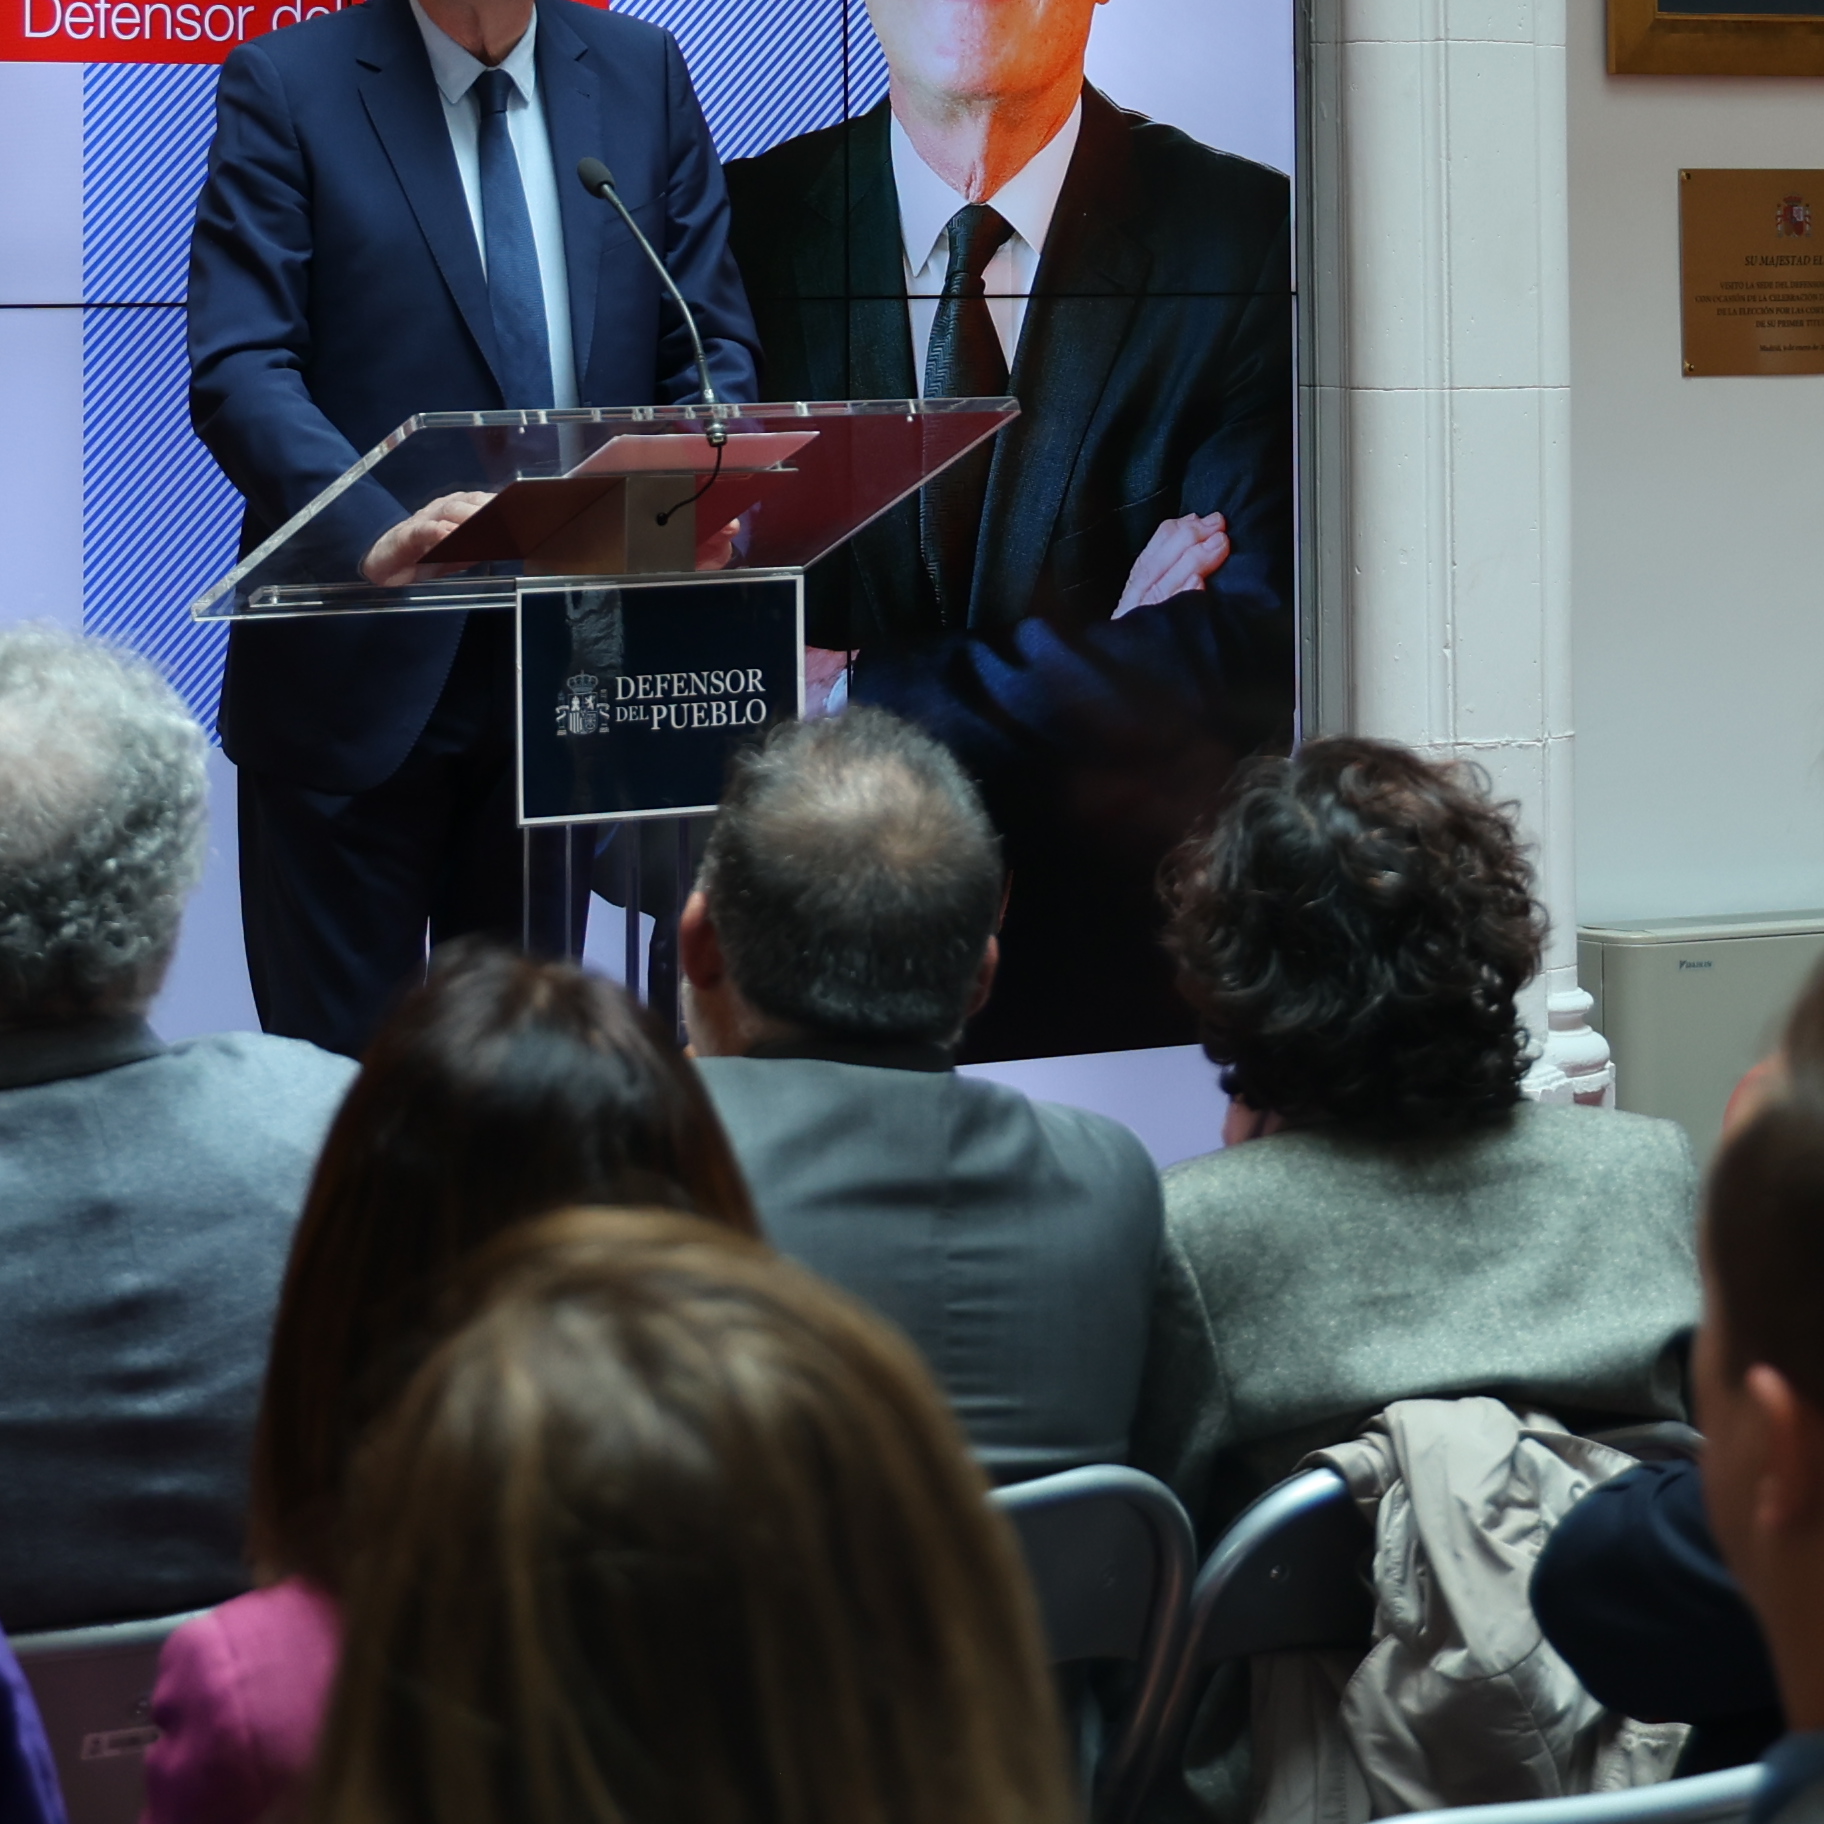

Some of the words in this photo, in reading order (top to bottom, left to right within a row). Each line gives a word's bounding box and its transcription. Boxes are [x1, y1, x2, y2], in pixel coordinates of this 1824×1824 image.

[1744, 255, 1758, 266] SU
[1759, 255, 1811, 268] MAJESTAD
[1812, 255, 1824, 266] EL
[615, 668, 766, 700] DEFENSOR
[615, 704, 650, 722] DEL
[650, 698, 767, 730] PUEBLO
